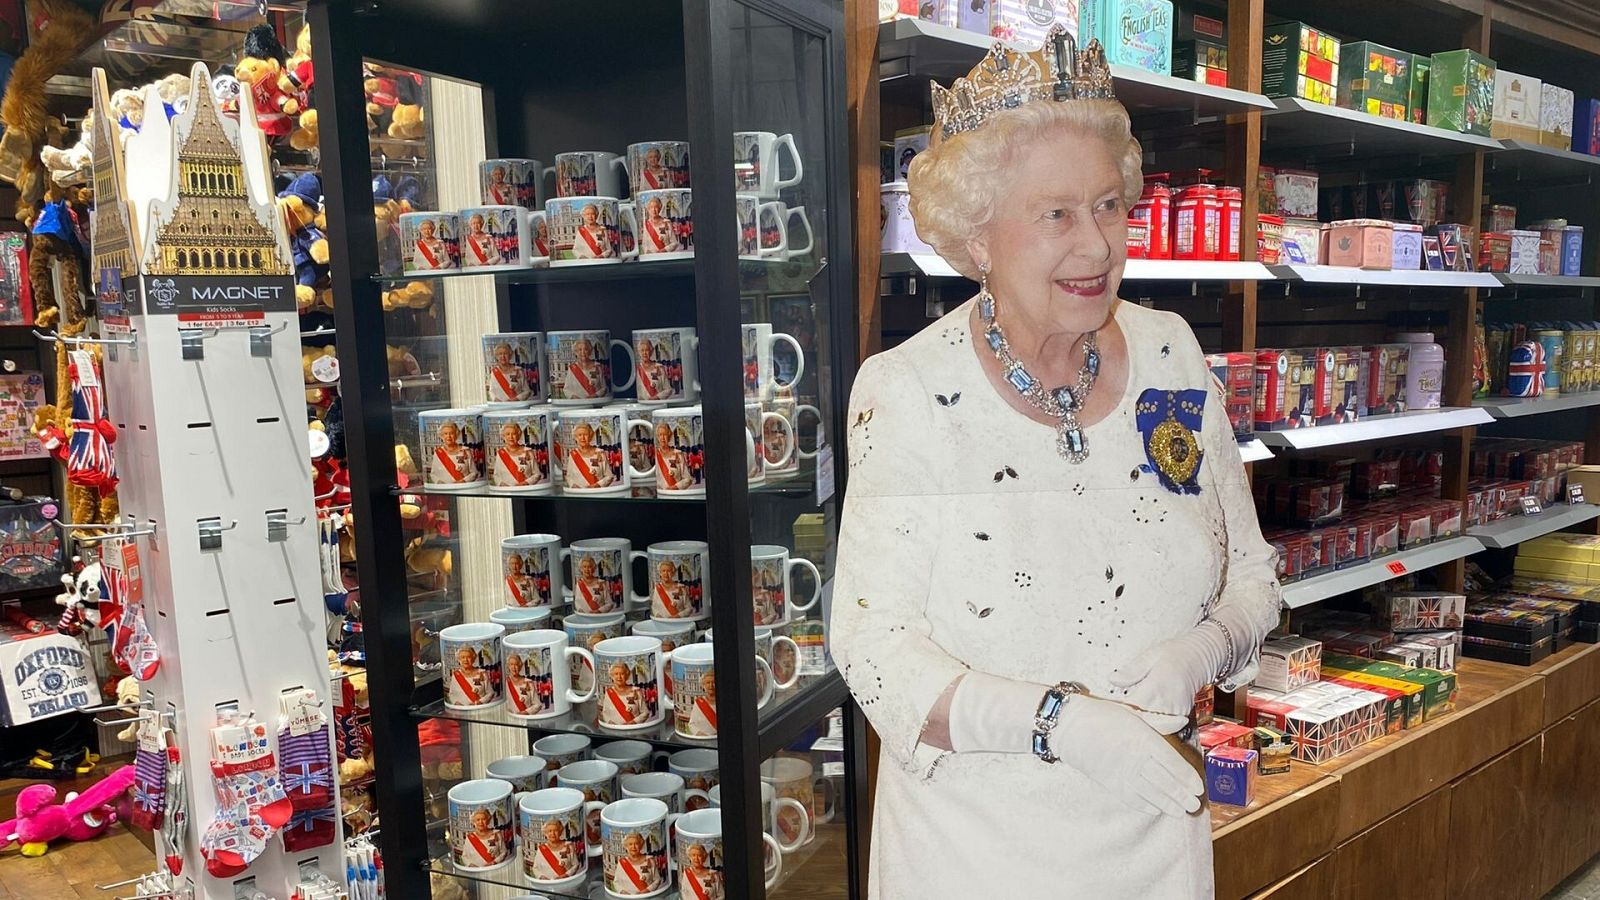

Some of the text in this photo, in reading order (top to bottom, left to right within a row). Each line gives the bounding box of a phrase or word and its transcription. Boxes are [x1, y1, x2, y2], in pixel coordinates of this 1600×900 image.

[1121, 13, 1150, 44] ENGLISH
[1151, 8, 1166, 30] TEAS
[192, 286, 283, 300] MAGNET
[15, 646, 84, 687] OXFORD
[29, 691, 88, 718] ENGLAND
